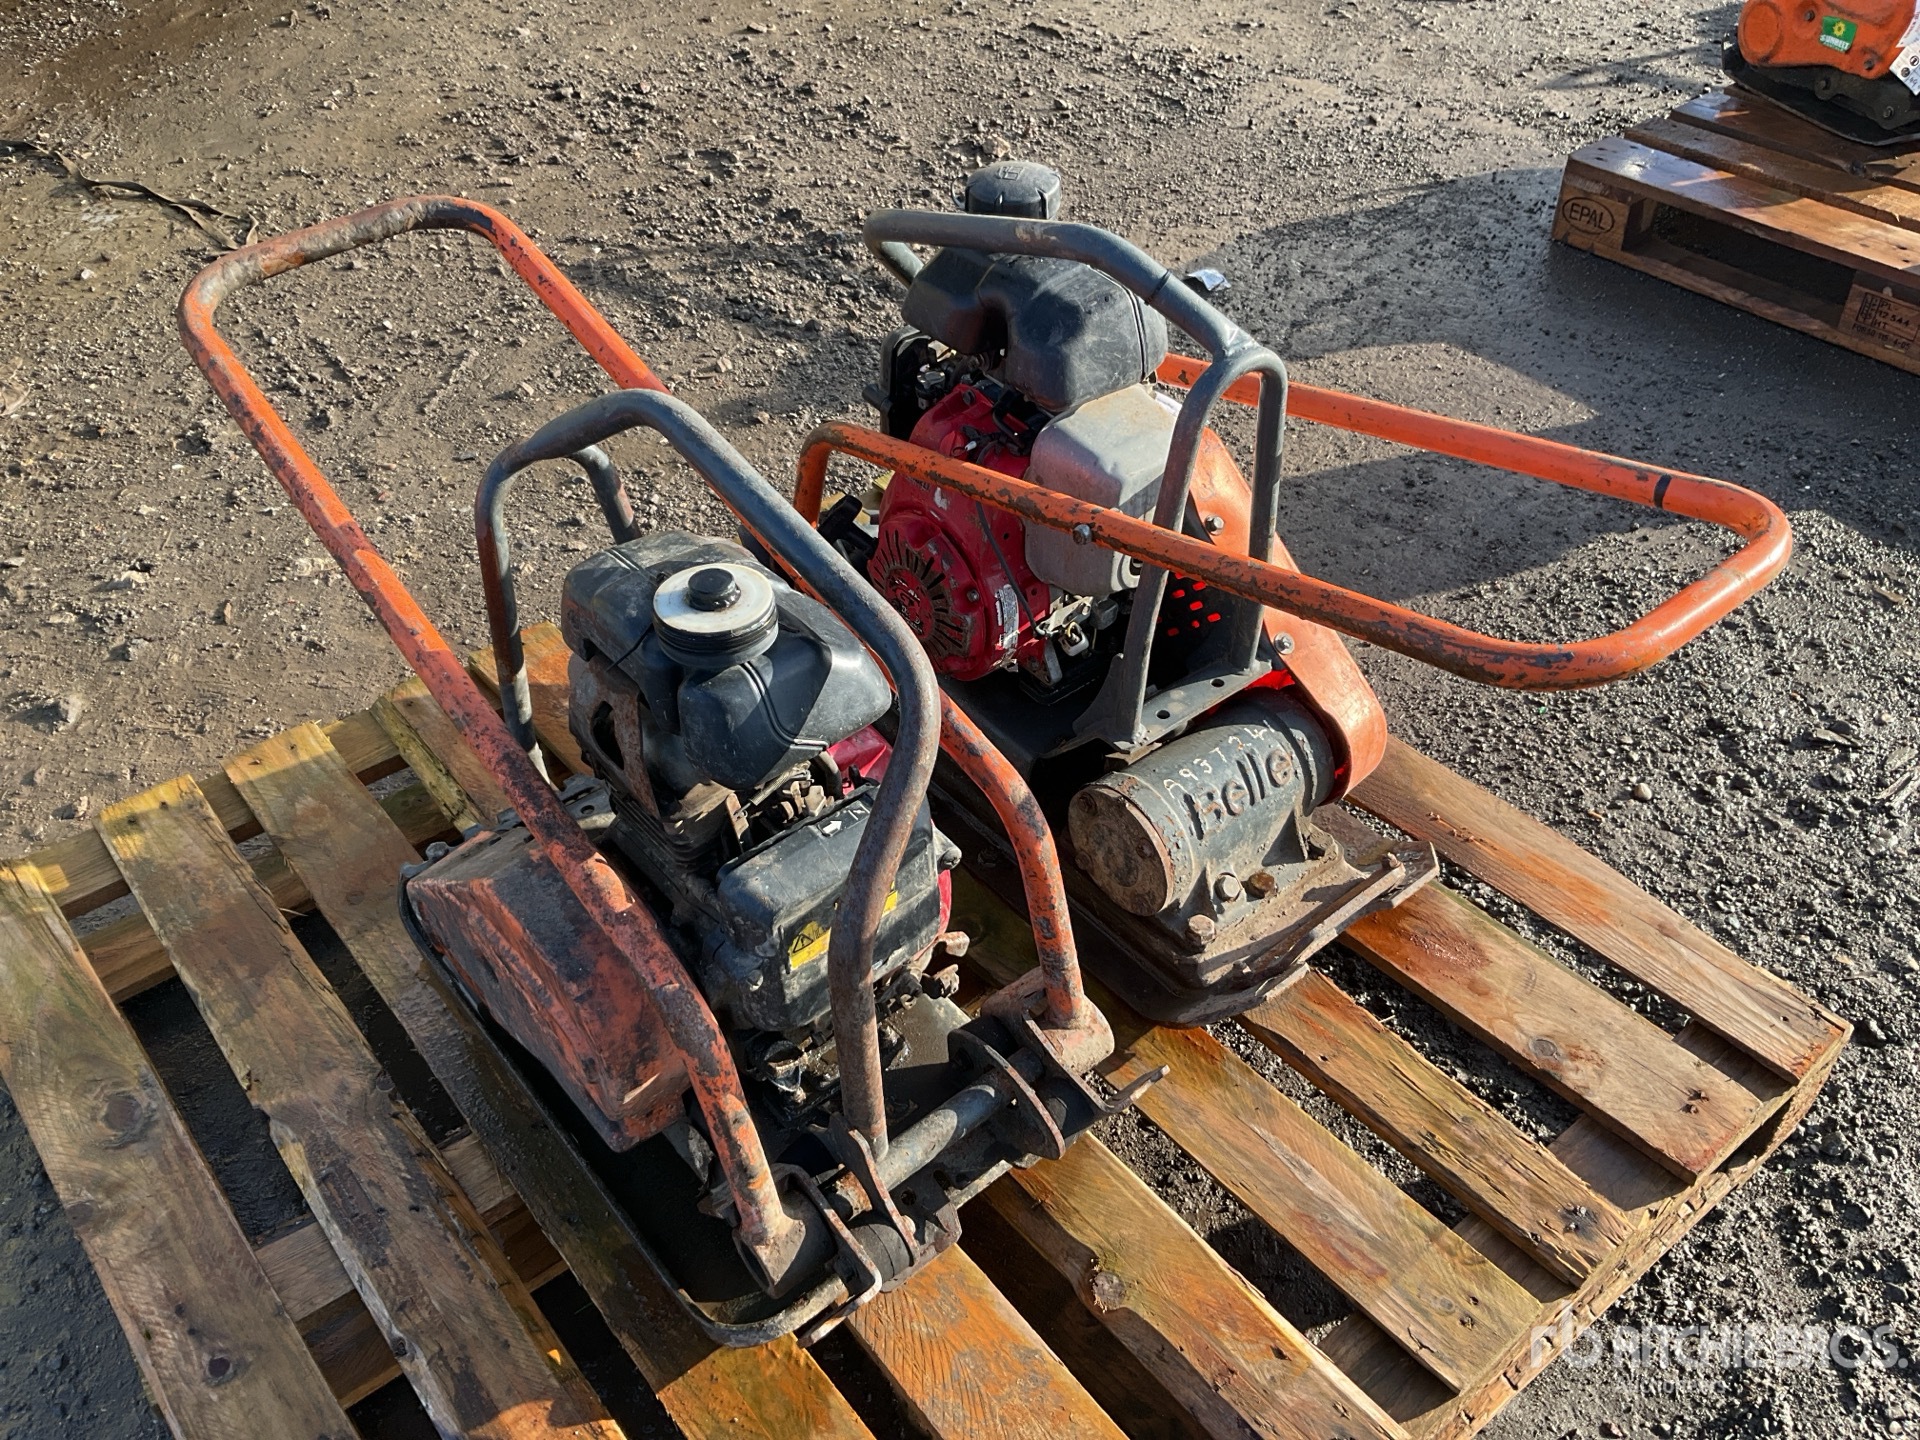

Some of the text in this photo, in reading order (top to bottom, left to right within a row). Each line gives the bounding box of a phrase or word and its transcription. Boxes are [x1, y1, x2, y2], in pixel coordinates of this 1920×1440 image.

[1819, 34, 1850, 50] SUNBELT
[1569, 202, 1606, 231] EPAL
[1178, 748, 1293, 841] Belle
